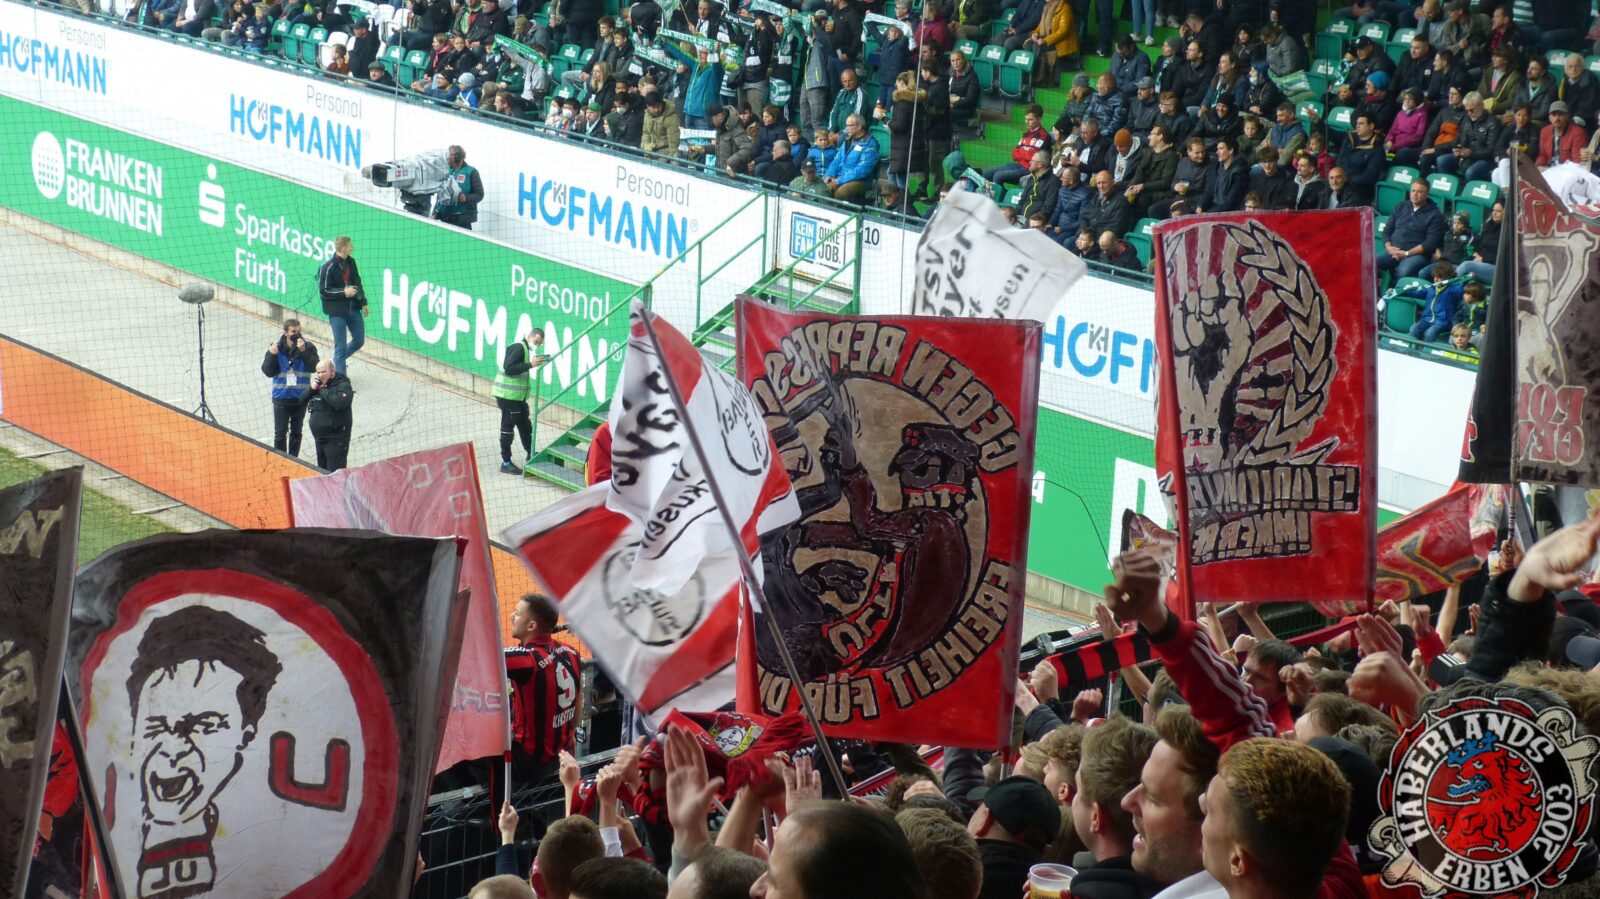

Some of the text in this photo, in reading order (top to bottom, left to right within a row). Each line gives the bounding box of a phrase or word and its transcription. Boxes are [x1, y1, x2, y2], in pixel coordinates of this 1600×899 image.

[0, 31, 107, 96] HOFMANN
[59, 20, 106, 50] Personal
[230, 93, 362, 169] HOFMANN
[306, 84, 362, 120] Personal
[66, 138, 163, 199] FRANKEN
[615, 165, 691, 207] Personal
[66, 175, 163, 236] BRUNNEN
[234, 203, 337, 261] Sparkasse
[517, 171, 688, 263] HOFMANN
[795, 219, 815, 239] KEIN
[818, 243, 842, 264] JOB.
[864, 226, 880, 246] 10
[234, 247, 287, 295] Fürth
[511, 264, 610, 327] Personal
[383, 268, 608, 405] HOFMANN
[1041, 314, 1154, 394] HOF
[555, 661, 576, 709] 9
